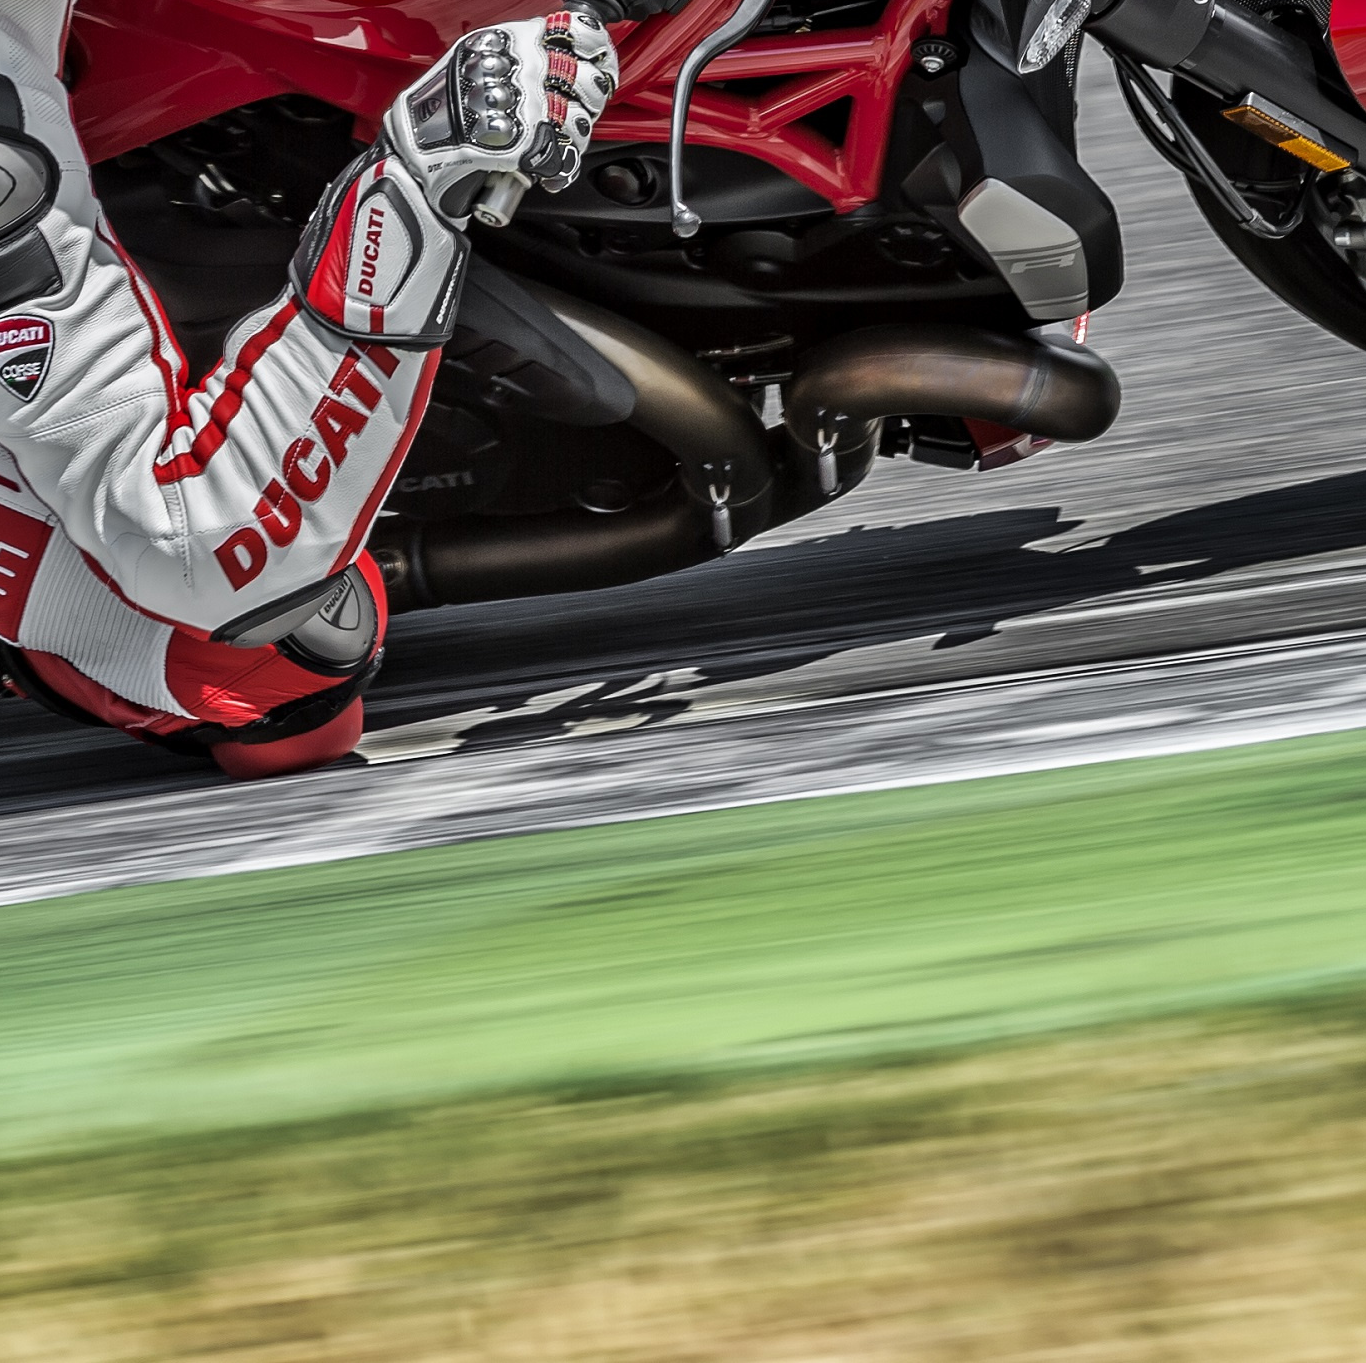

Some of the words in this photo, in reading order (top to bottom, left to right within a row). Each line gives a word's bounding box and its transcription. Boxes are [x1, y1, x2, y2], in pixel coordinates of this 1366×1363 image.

[358, 207, 385, 297] DUCATI
[1, 362, 42, 379] CORSE
[213, 340, 401, 593] DUCATI
[396, 471, 474, 493] CATI
[323, 578, 349, 614] DUCATI
